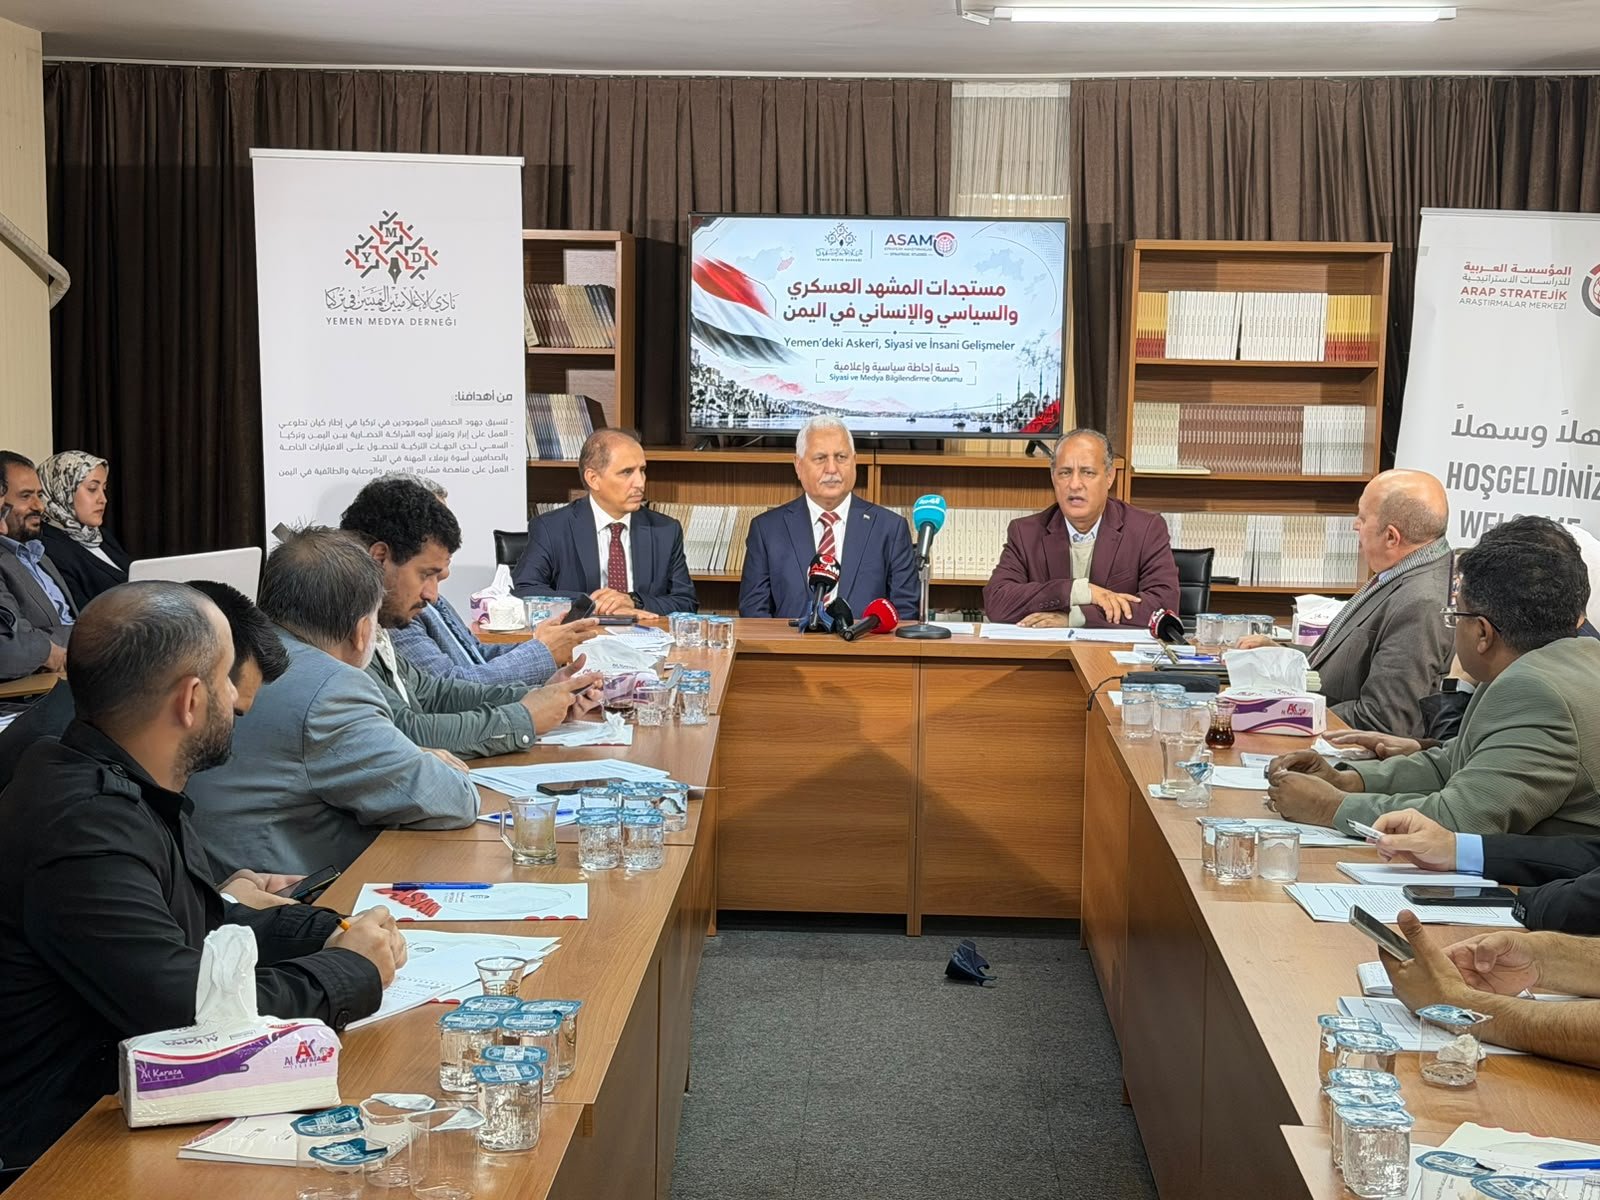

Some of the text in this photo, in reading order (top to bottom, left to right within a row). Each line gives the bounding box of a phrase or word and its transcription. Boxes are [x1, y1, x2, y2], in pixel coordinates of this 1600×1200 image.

[884, 233, 933, 246] ASAM
[787, 275, 1006, 301] مستجدات المشهد العسكري
[1460, 286, 1568, 301] ARAP STRATEJİK
[1458, 297, 1567, 310] ARAŞTIRMALAR MERKEZİ
[326, 317, 363, 326] YEMEN
[368, 317, 405, 326] MEDYA
[783, 301, 1019, 329] والسياسي والإنساني في اليمن
[884, 338, 914, 351] Siyasi
[915, 341, 927, 350] ve
[929, 338, 960, 350] İnsani
[961, 339, 1016, 352] Gelişmeler
[833, 361, 960, 374] جلسة إحاطة سياسية وإعلامية
[829, 373, 849, 382] Siyasi
[860, 374, 884, 383] Medya
[885, 375, 930, 383] Bilgilendirme
[496, 393, 513, 403] من
[1555, 409, 1600, 446] هلاً
[1446, 461, 1600, 501] HOŞGELDİNİZ
[152, 1068, 183, 1078] Karaza
